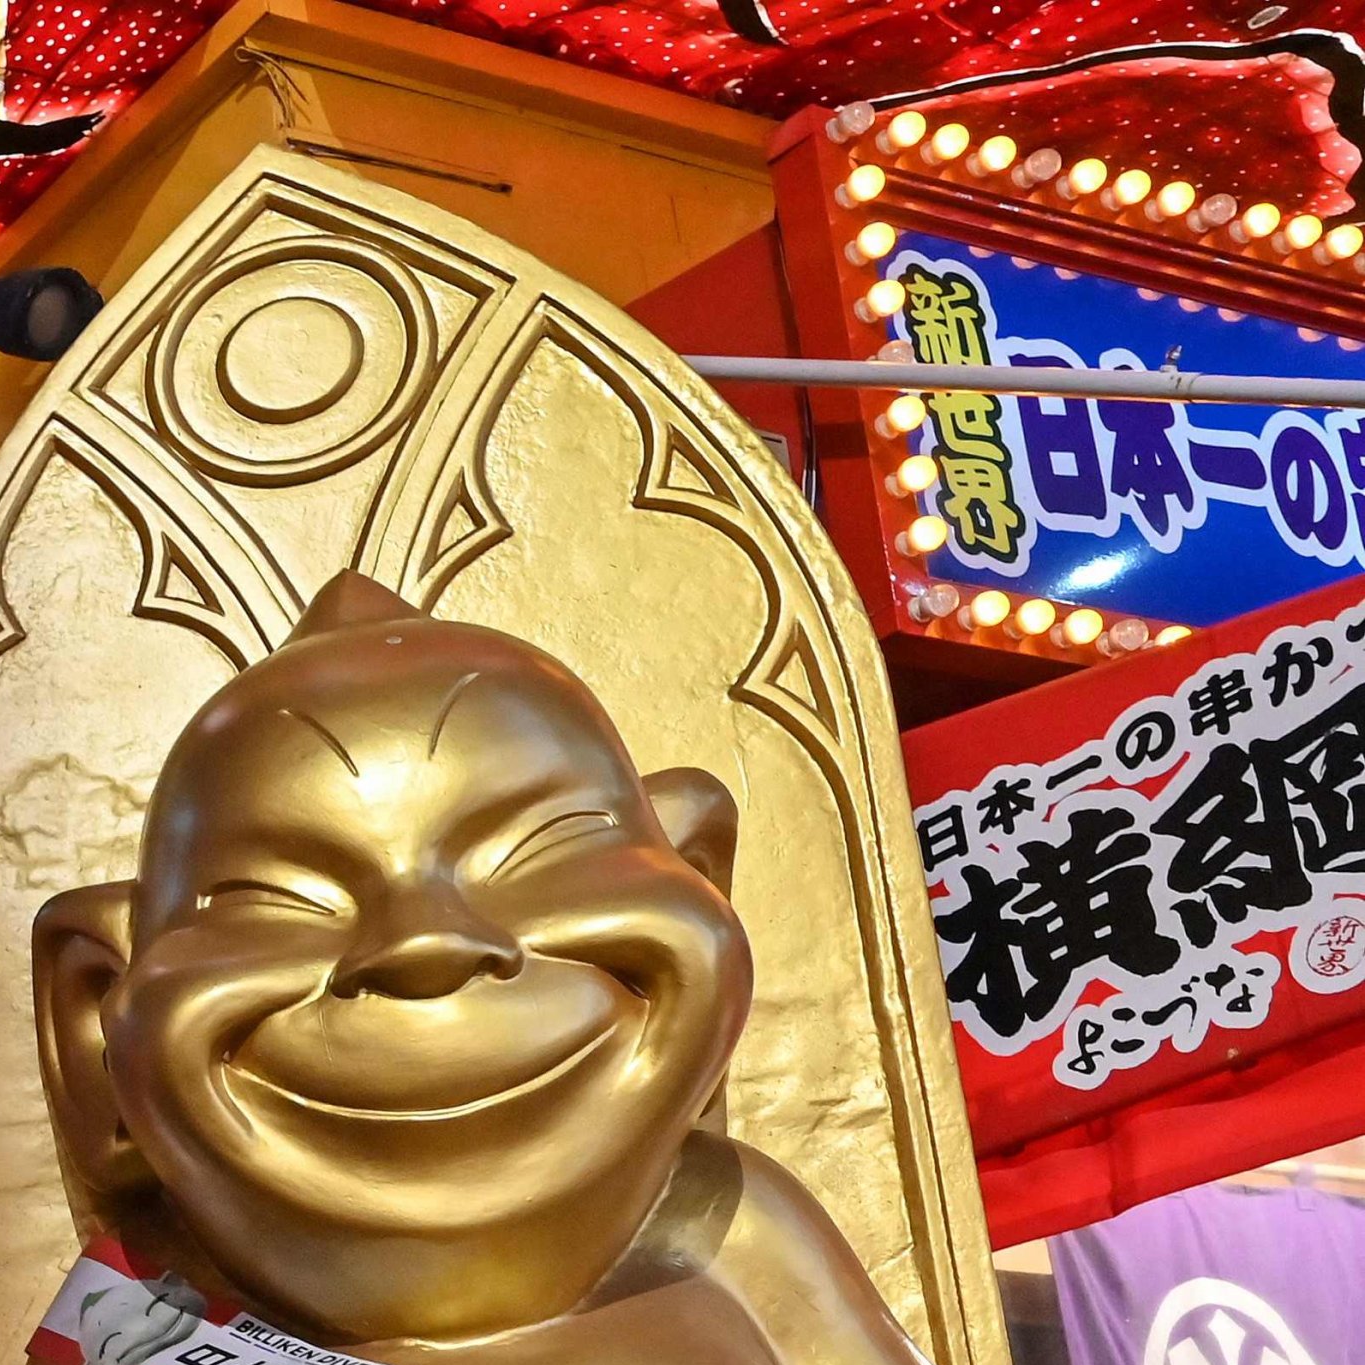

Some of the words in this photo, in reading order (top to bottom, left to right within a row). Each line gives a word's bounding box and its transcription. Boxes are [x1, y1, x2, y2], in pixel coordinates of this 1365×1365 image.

[909, 272, 1018, 554] 新世界
[1009, 354, 1365, 552] 日本一の
[918, 615, 1365, 870] 日本一の串か
[935, 682, 1365, 1037] 横綱
[1067, 964, 1265, 1075] よこづな
[234, 1319, 320, 1361] BILLIKEN
